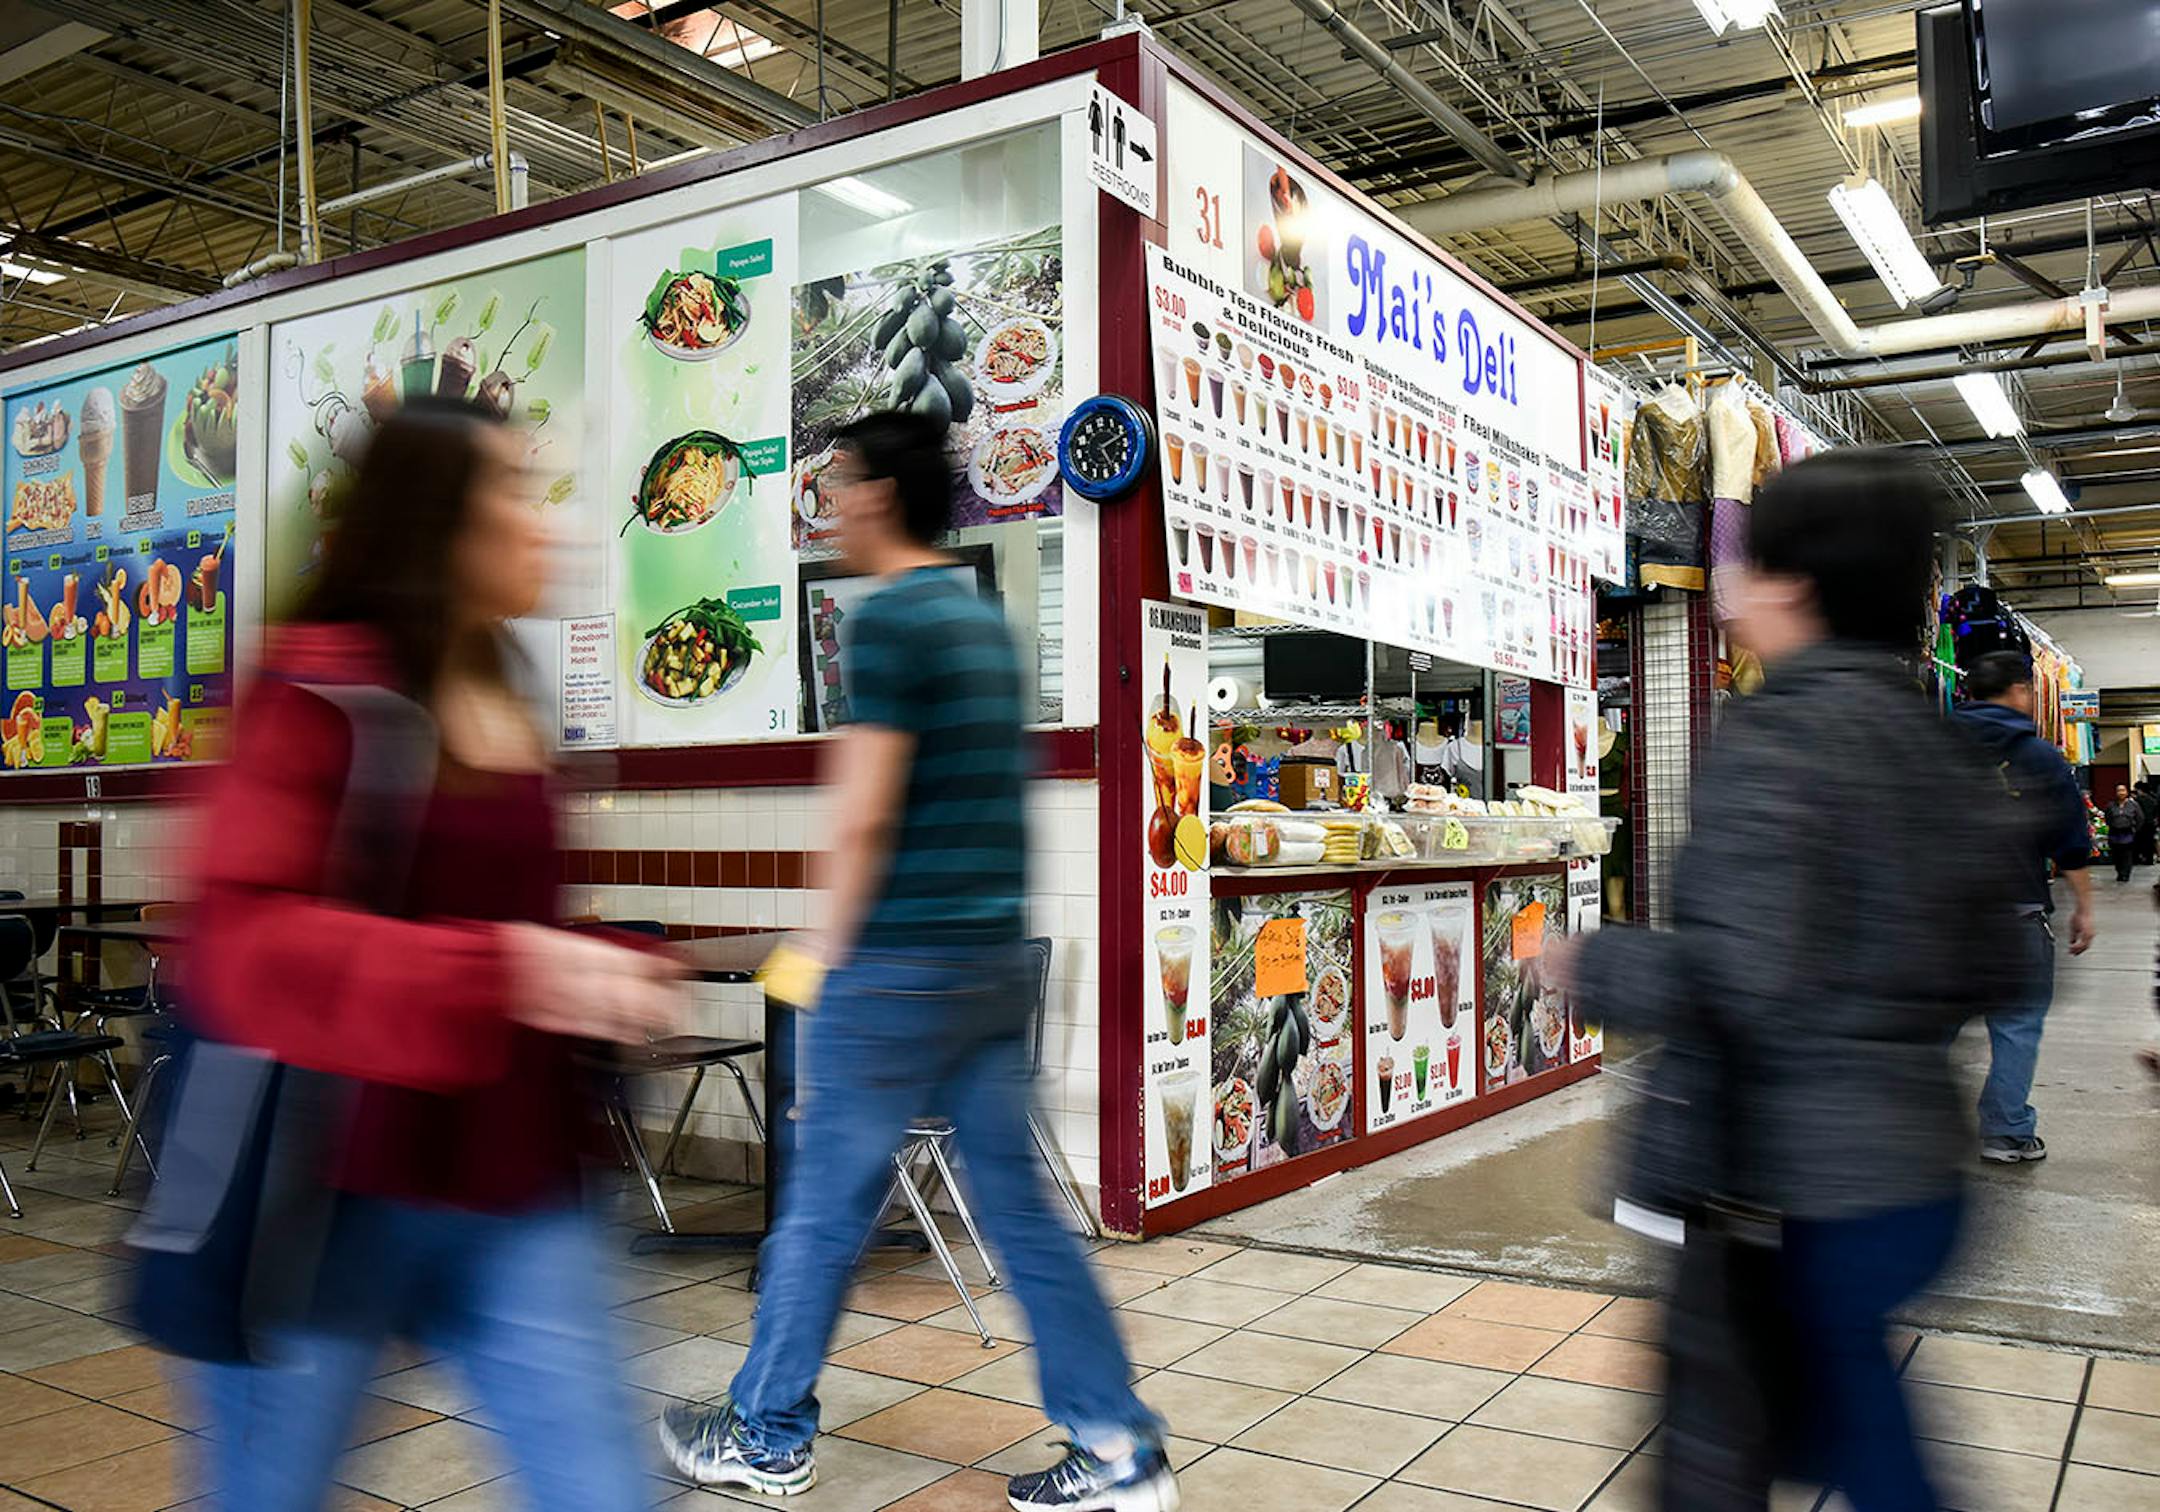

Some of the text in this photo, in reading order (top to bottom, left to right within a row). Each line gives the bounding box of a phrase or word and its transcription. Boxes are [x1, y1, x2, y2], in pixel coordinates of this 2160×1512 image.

[1093, 161, 1150, 208] RESTROOMS
[1196, 186, 1223, 249] 31
[1155, 285, 1186, 320] $3.00
[1163, 255, 1224, 298] Bubble
[1228, 289, 1256, 315] Tea
[1260, 306, 1314, 343] Flavors
[1317, 335, 1354, 364] Fresh
[1347, 234, 1518, 406] Mai's Deli
[1223, 307, 1234, 321] &
[1238, 312, 1309, 358] Delicious
[1492, 427, 1540, 466] Milkshakes
[1171, 633, 1201, 650] Delicious
[768, 708, 786, 730] 31
[1151, 870, 1187, 899] $4.00
